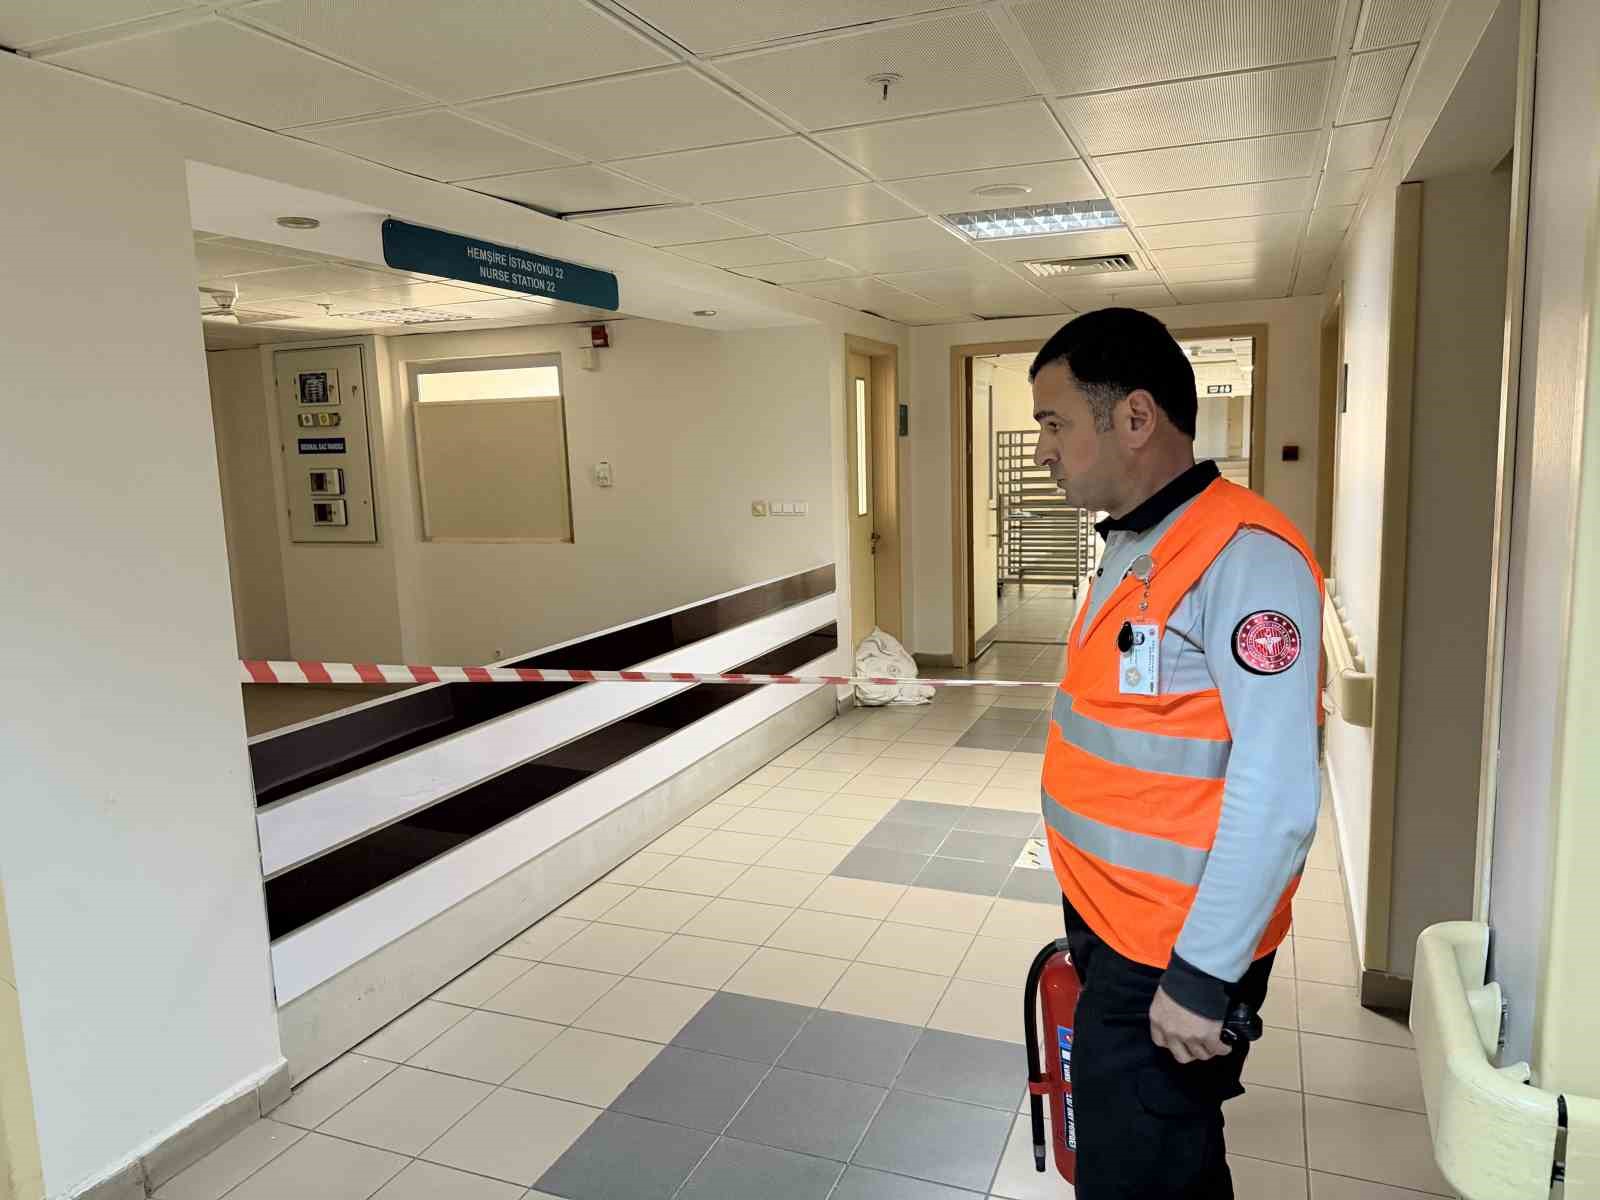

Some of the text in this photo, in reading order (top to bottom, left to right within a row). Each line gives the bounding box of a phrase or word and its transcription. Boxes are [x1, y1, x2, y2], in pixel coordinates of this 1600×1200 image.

[467, 246, 564, 279] HEMŞİRE İSTASYONU 22
[480, 266, 556, 292] NURSE STATION 22
